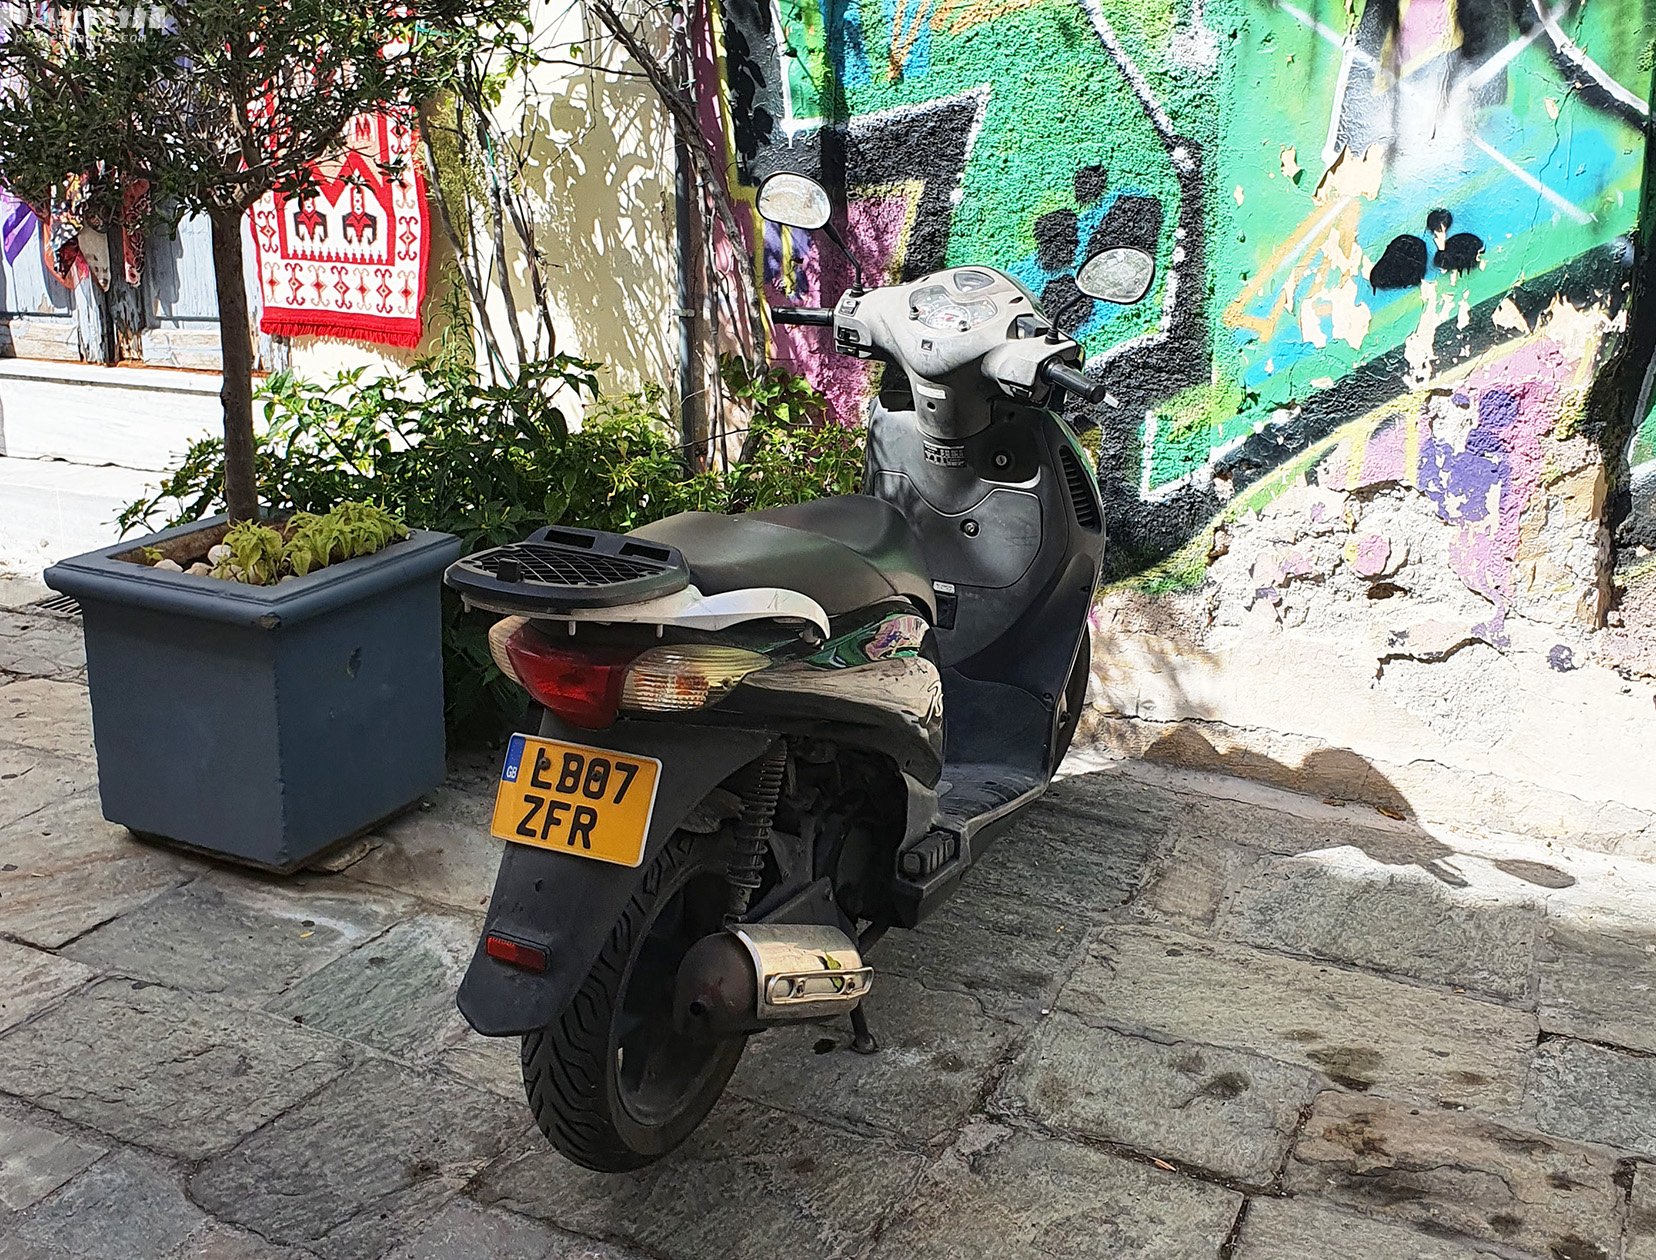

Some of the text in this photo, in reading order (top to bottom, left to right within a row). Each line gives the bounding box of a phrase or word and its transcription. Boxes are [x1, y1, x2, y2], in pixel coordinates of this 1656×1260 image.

[506, 765, 518, 779] GB
[530, 747, 639, 805] LB07
[516, 794, 598, 849] ZFR
